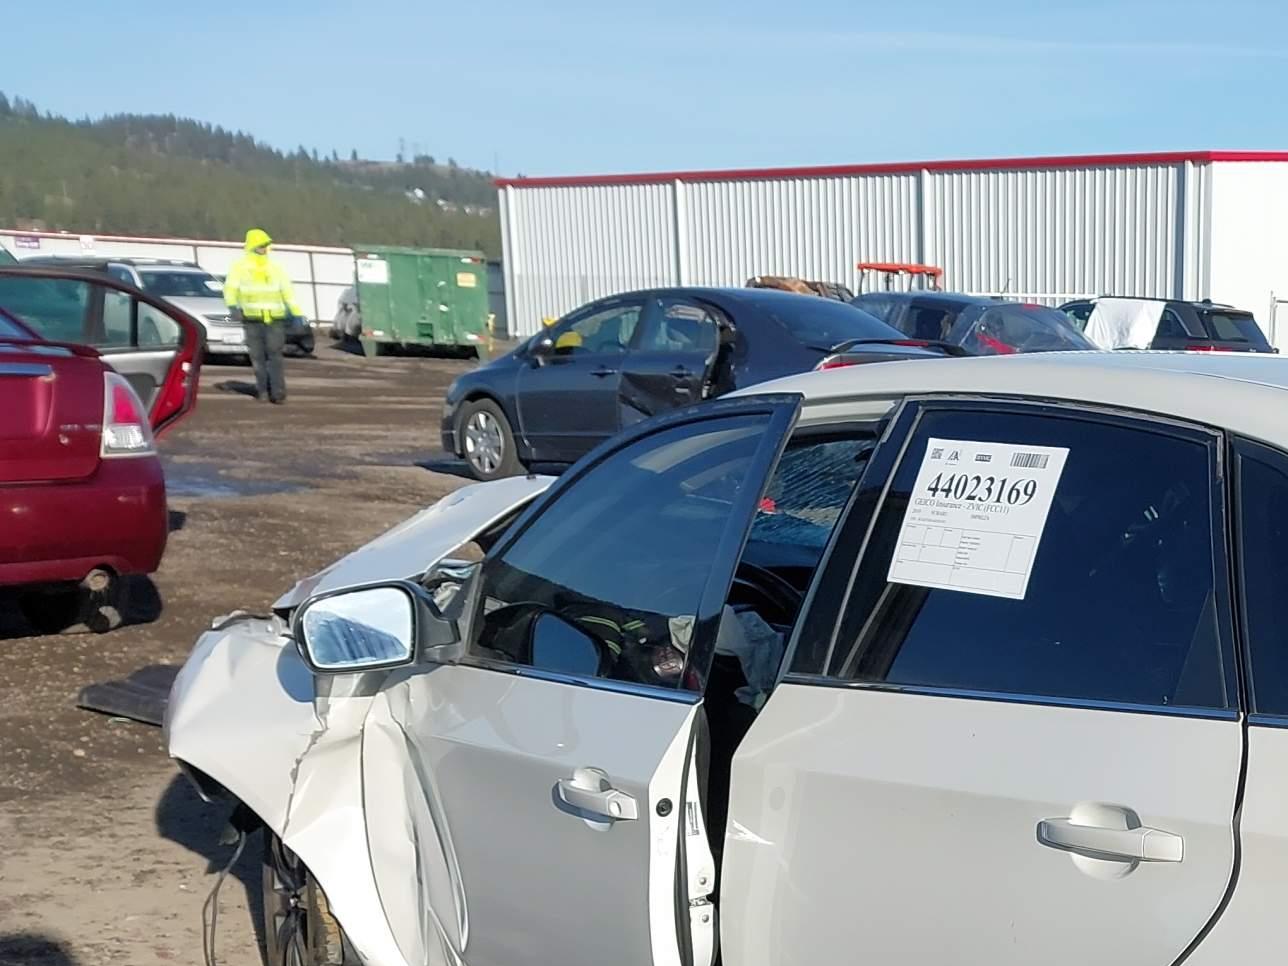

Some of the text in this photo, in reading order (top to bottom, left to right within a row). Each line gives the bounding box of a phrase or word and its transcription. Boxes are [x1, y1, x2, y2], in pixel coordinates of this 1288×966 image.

[927, 472, 1037, 506] 44023169
[914, 498, 934, 506] GEICO
[936, 500, 962, 509] Insurance
